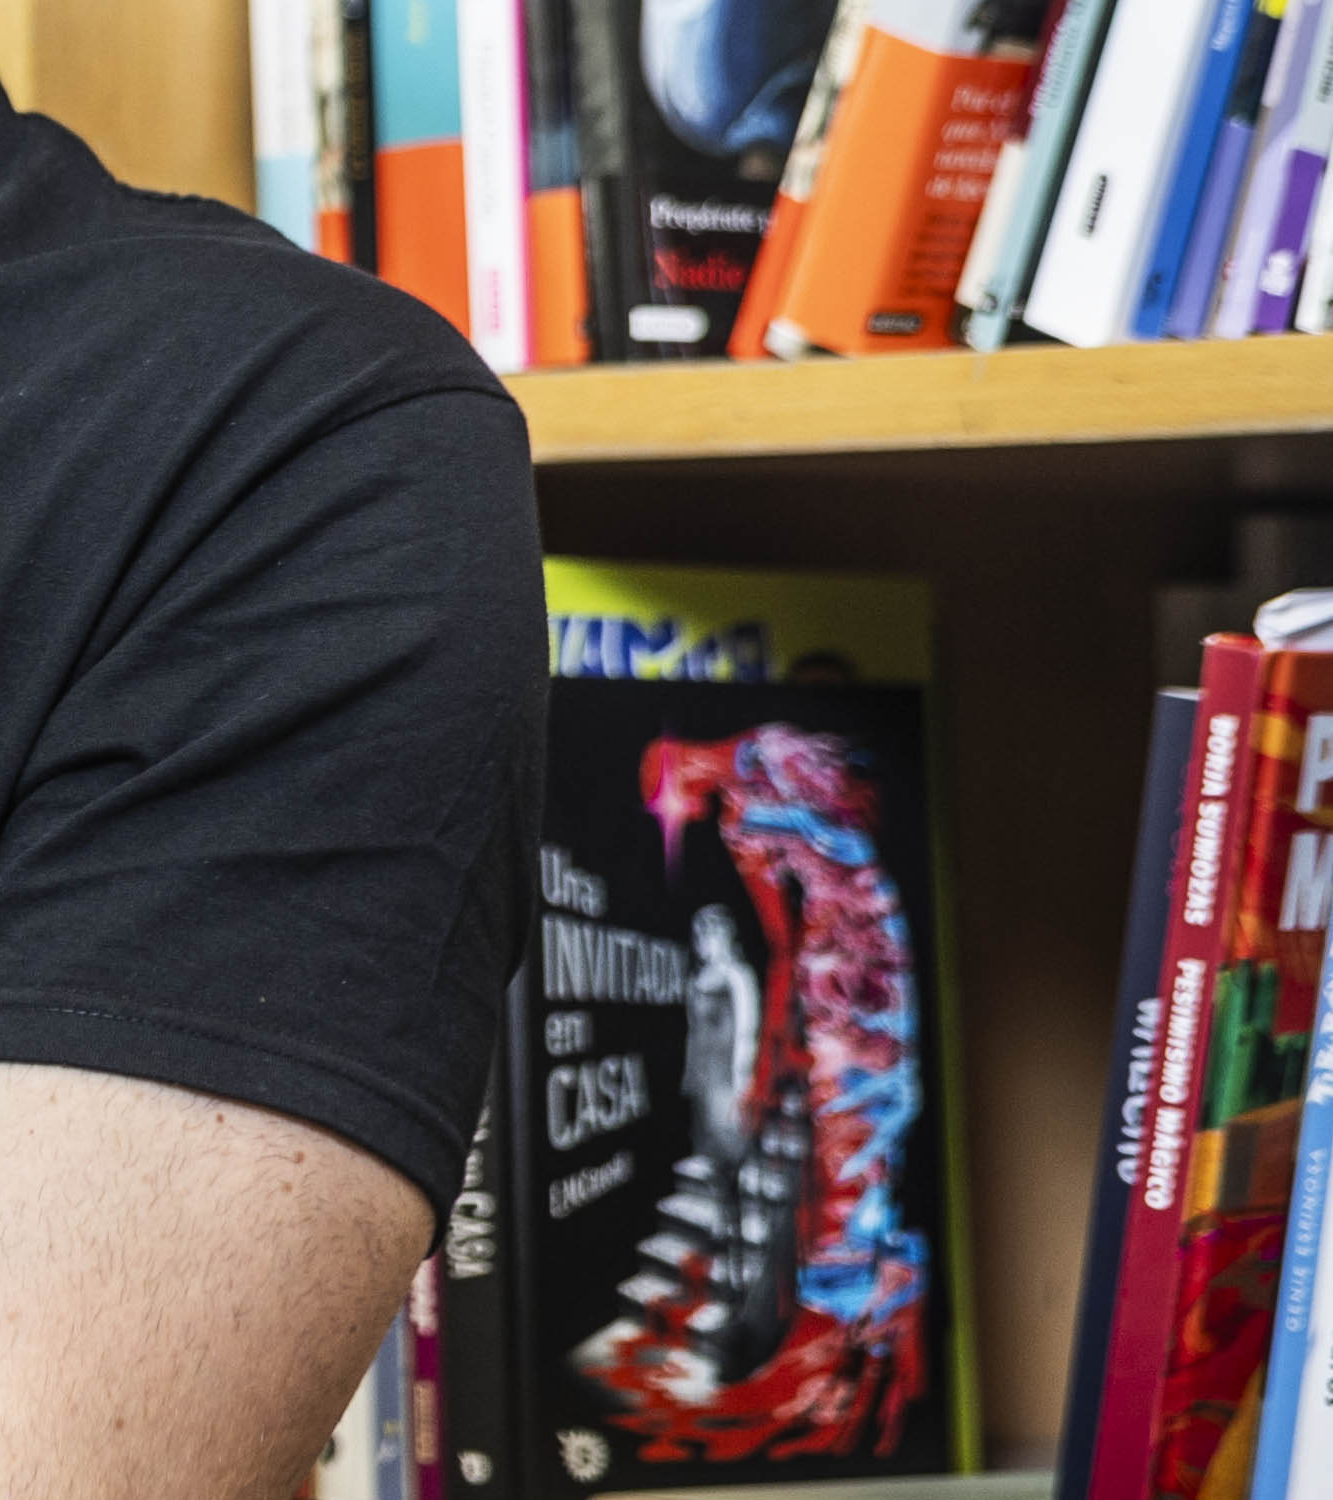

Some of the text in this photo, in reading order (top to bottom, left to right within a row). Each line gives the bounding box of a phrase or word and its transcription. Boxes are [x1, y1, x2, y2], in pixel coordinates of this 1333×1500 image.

[540, 843, 607, 917] Una
[541, 911, 690, 1004] INVITADA
[544, 1009, 595, 1056] en
[1160, 958, 1207, 1102] PESIMISMO
[545, 1052, 651, 1150] CASA
[1286, 1148, 1328, 1332] GENIE ESPINOSA
